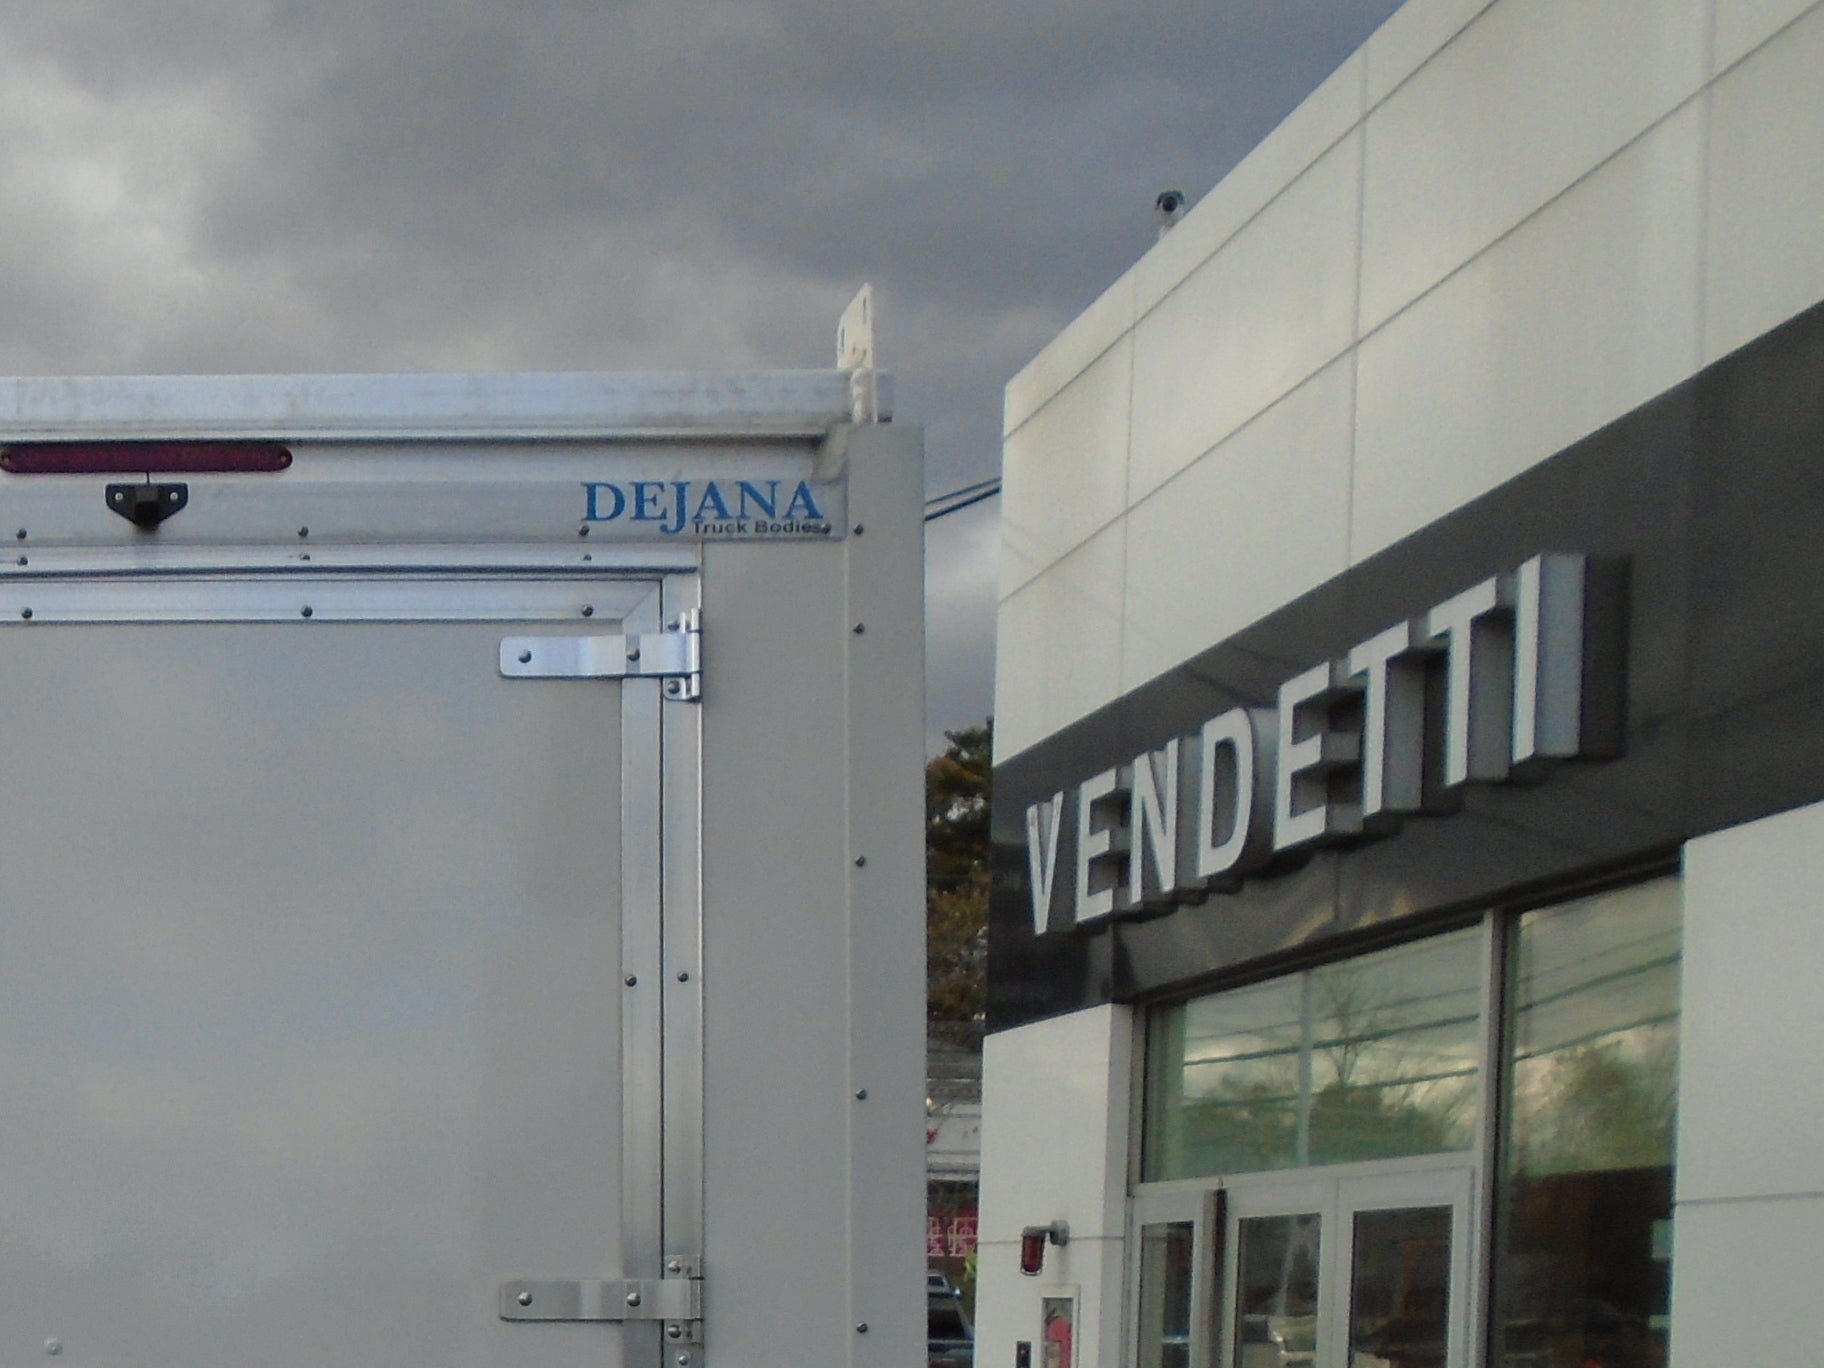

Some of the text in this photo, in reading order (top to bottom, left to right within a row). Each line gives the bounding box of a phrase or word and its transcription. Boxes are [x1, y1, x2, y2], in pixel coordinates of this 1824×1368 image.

[580, 480, 824, 535] DEJANA
[693, 519, 822, 534] Truck Bodies
[1026, 551, 1581, 935] VENDETTI
